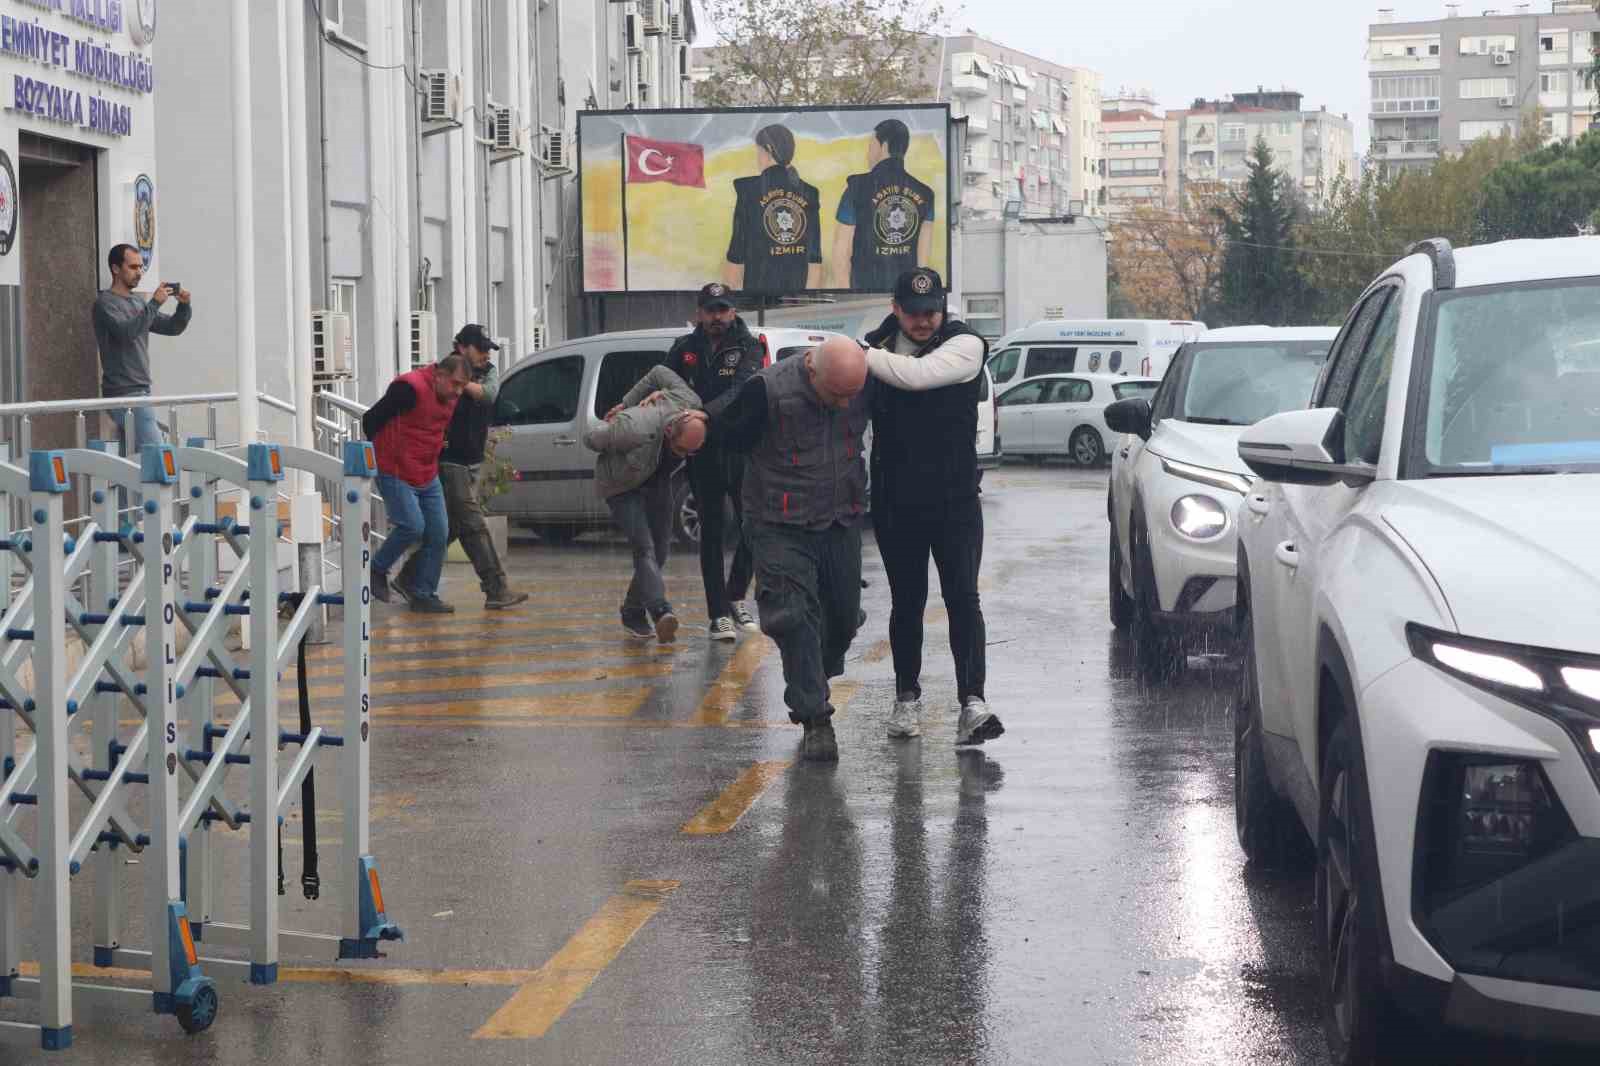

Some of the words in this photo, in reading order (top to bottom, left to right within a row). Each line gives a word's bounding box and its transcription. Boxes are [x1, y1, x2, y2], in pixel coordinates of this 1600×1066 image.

[1, 14, 70, 68] EMNİYET
[75, 36, 153, 93] MÜDÜRLÜĞÜ
[14, 74, 84, 125] BOZYAKA
[89, 90, 132, 136] BİNASI
[163, 563, 176, 744] POLİS
[361, 550, 370, 713] POLİS
